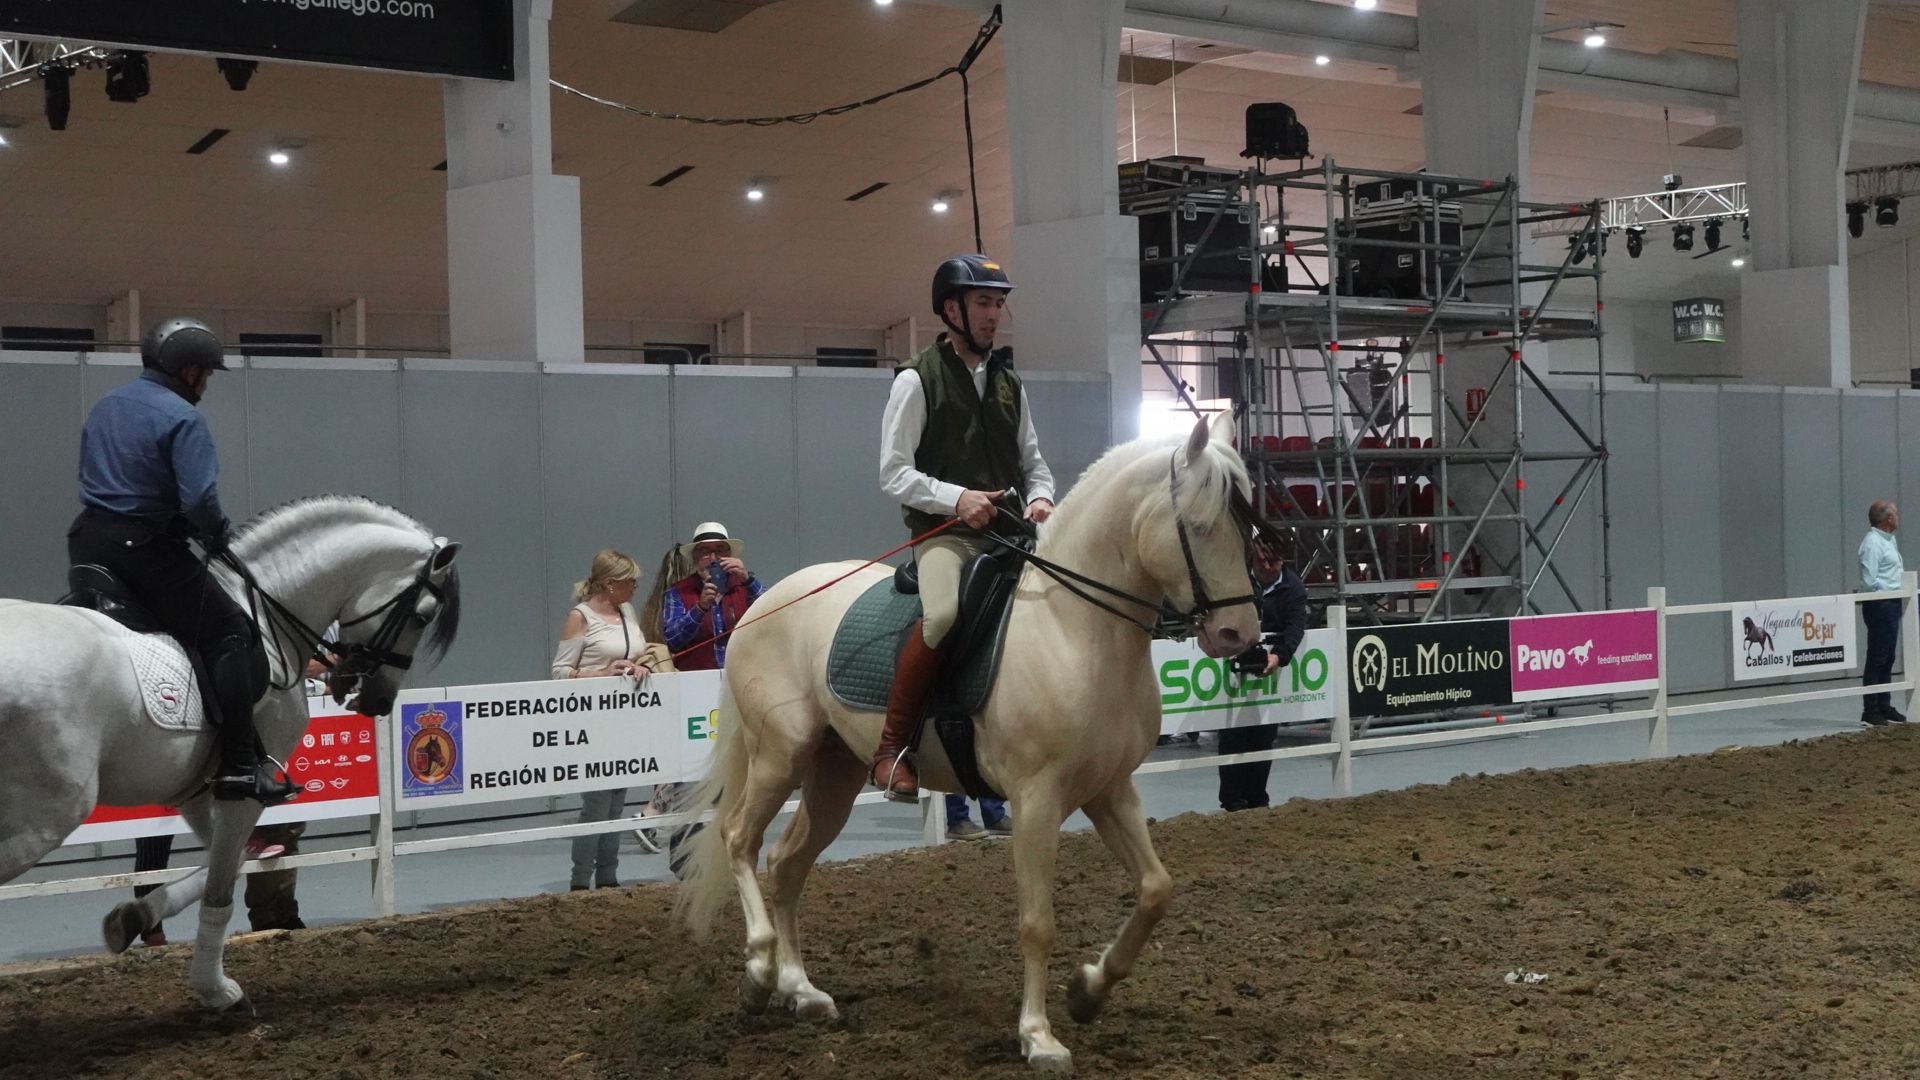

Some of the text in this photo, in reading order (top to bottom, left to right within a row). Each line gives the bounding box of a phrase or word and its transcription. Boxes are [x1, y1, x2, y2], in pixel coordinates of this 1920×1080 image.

[1674, 303, 1702, 319] W.C.
[1703, 303, 1724, 318] W.C.
[1802, 611, 1837, 645] Bejar
[1392, 656, 1411, 678] EL
[1517, 644, 1653, 673] Pavo feeding excellence
[1745, 650, 1844, 668] Caballos y celebraciones
[465, 690, 662, 719] FEDERACIÓN HÍPICA
[1283, 692, 1327, 704] HORIZONTE
[1386, 687, 1472, 708] Equipamiento Hípico
[320, 733, 335, 746] FIAT
[532, 729, 590, 748] DE LA
[470, 757, 660, 790] REGIÓN DE MURCIA
